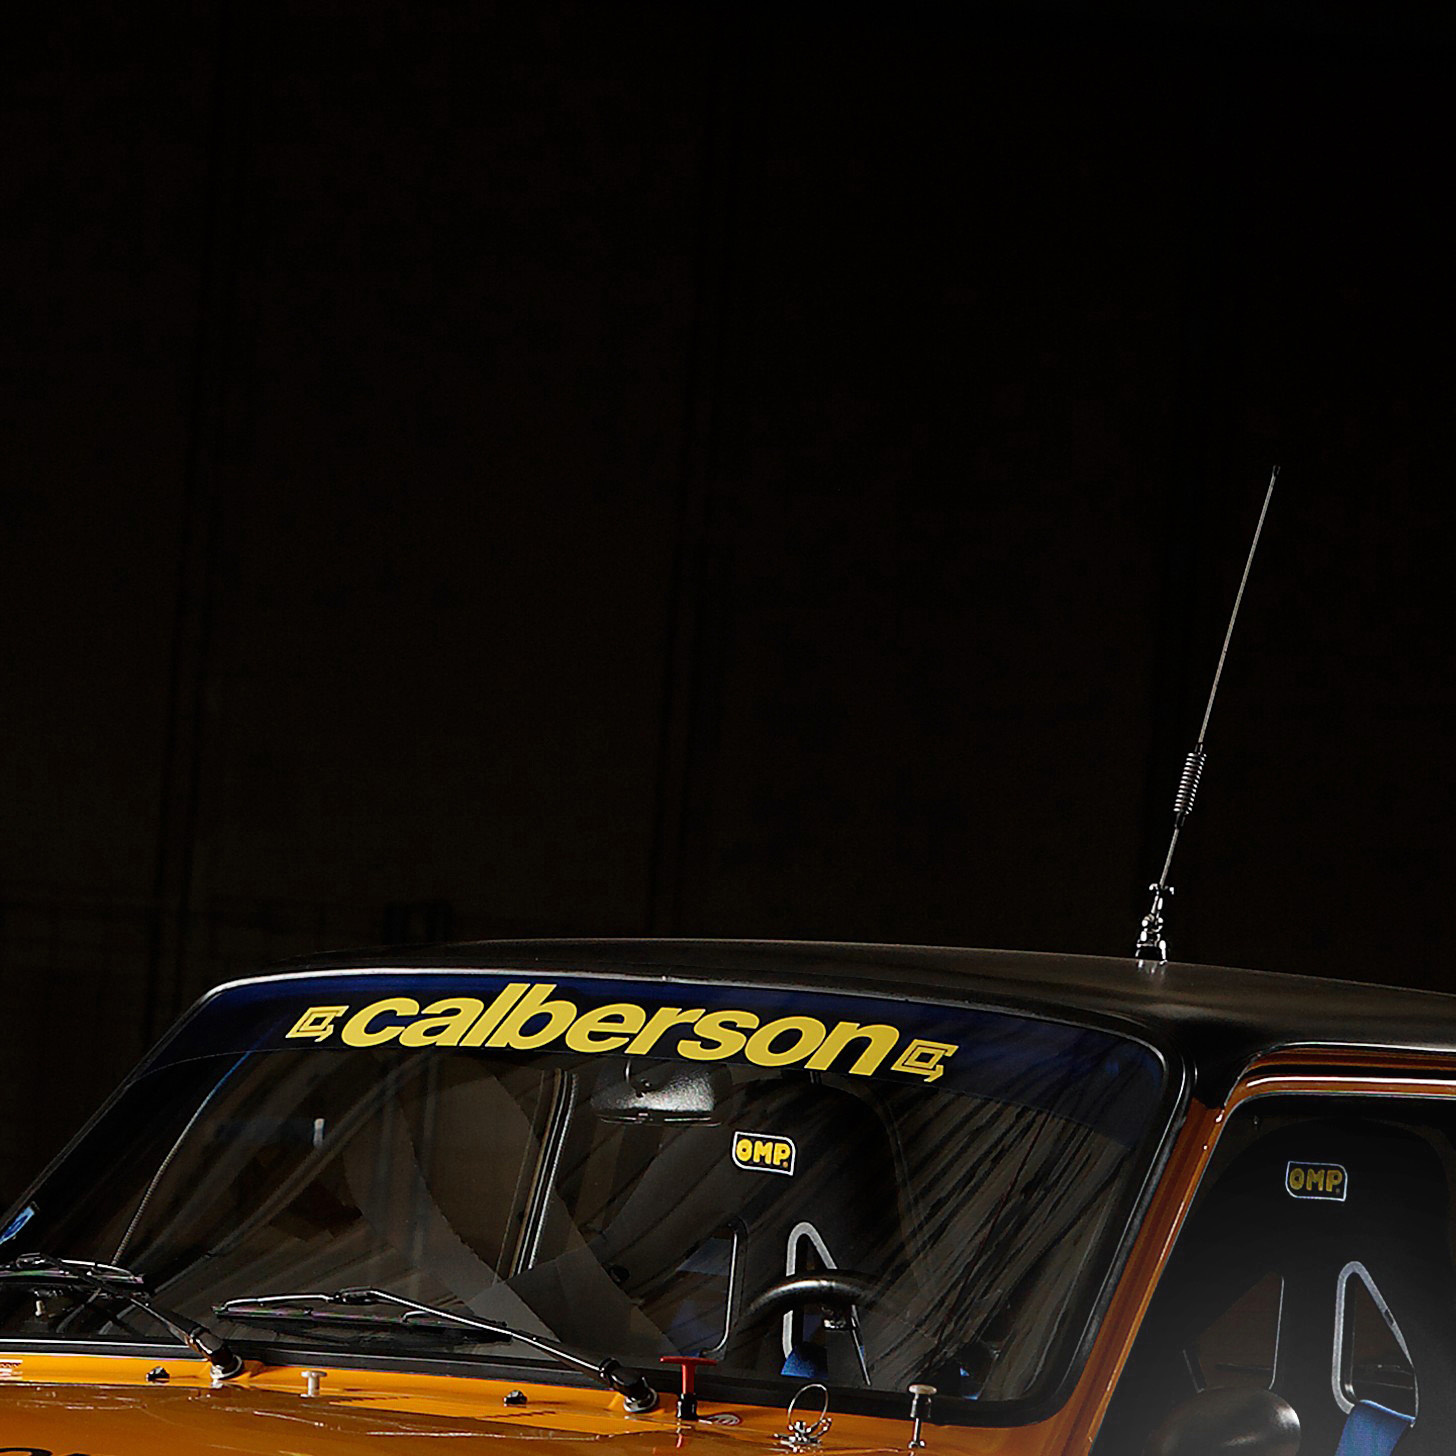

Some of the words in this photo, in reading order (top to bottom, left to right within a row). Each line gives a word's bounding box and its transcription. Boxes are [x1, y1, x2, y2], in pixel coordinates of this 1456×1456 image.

[341, 983, 899, 1076] calberson
[735, 1136, 790, 1168] OMP
[1289, 1168, 1343, 1194] OMP
